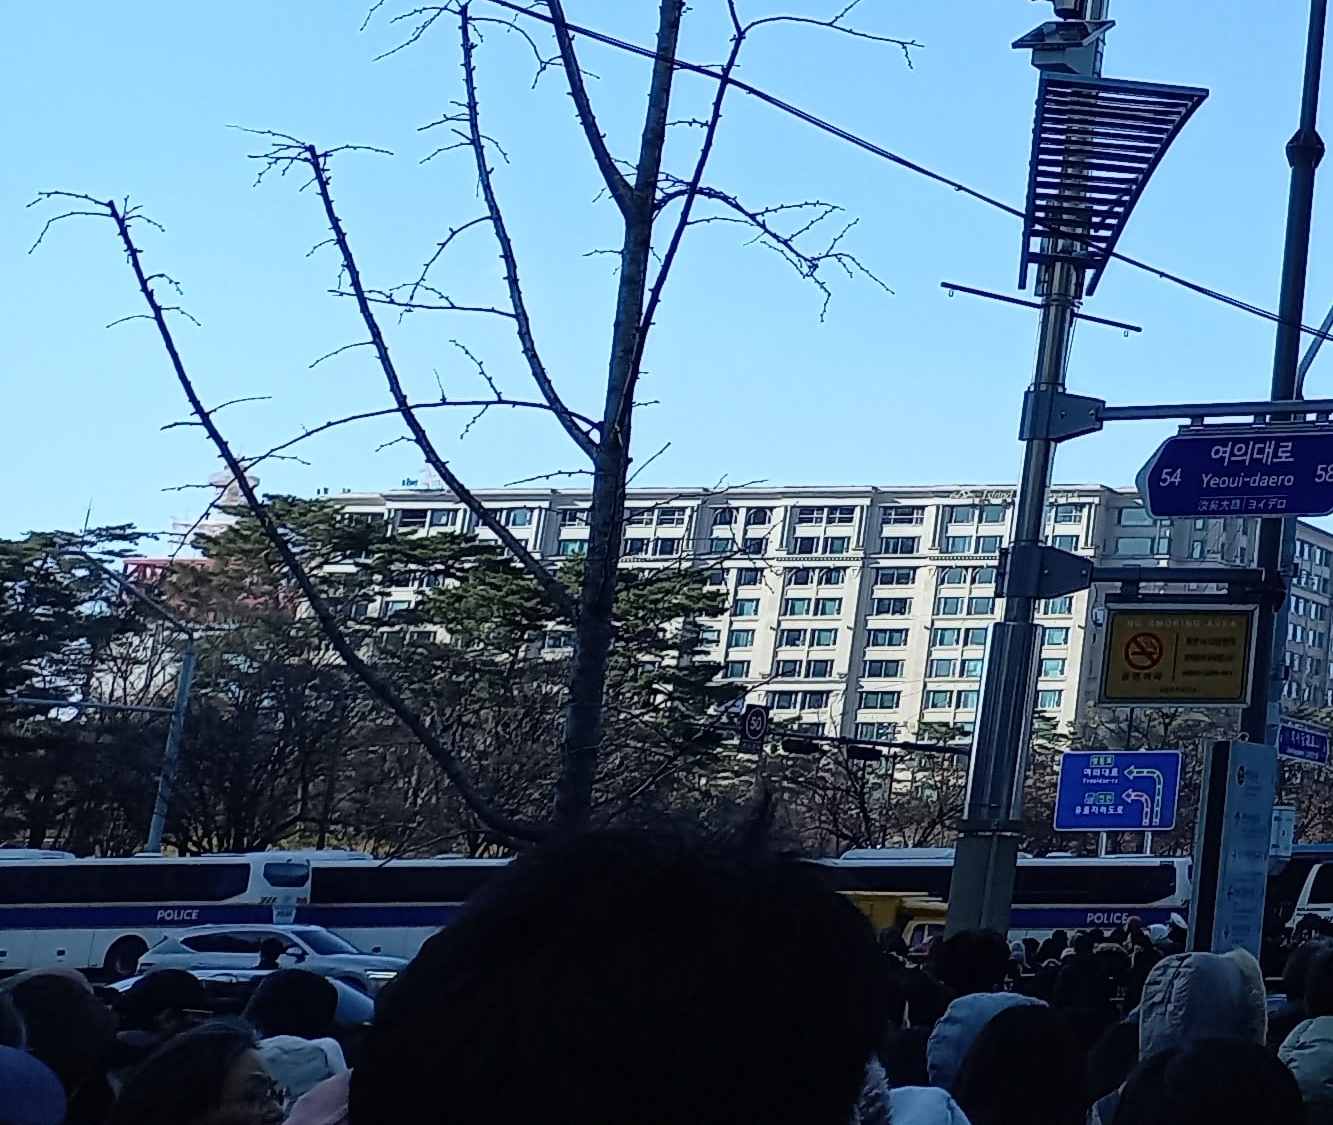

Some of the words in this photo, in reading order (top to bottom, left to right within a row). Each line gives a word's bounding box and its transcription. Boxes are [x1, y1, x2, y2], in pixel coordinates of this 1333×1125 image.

[1210, 440, 1295, 467] 여의대로
[1159, 467, 1182, 487] 54
[1201, 472, 1295, 489] Yeoui-daero
[749, 716, 762, 731] 50
[156, 909, 200, 921] POLICE
[1086, 912, 1129, 924] POLICE
